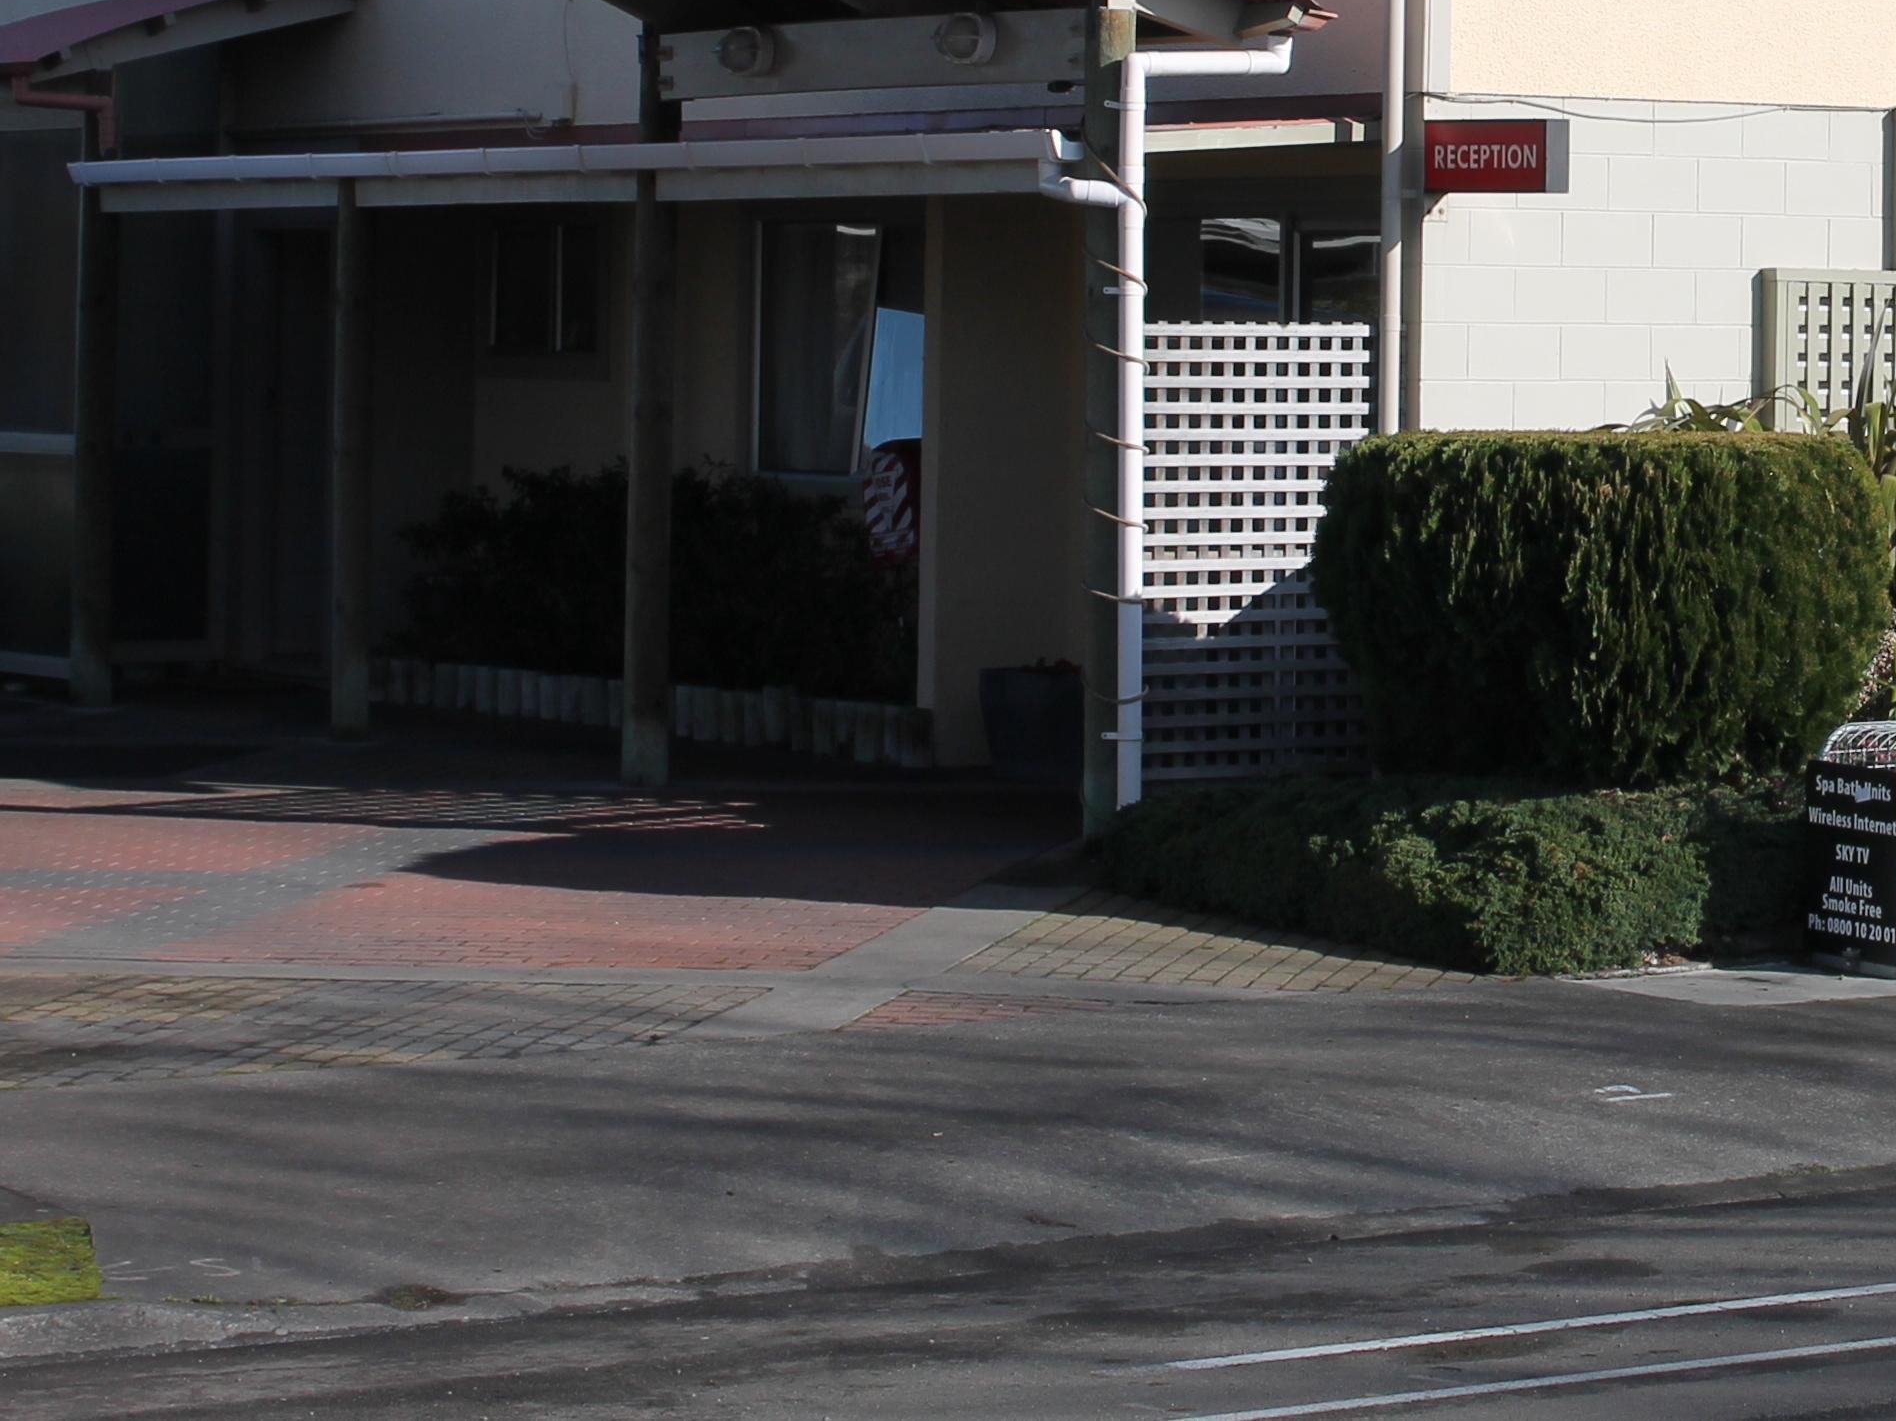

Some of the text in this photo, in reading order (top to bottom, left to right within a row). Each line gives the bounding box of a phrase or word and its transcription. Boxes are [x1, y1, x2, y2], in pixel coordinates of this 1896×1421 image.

[1434, 144, 1536, 169] RECEPTION
[1816, 774, 1835, 796] Spa
[1808, 806, 1896, 837] Wireless Internet
[1836, 843, 1869, 865] SKY TV
[1829, 876, 1872, 898] All Units
[1822, 893, 1882, 919] Smoke Free
[1808, 913, 1896, 944] Ph: 0800 10 20 01
